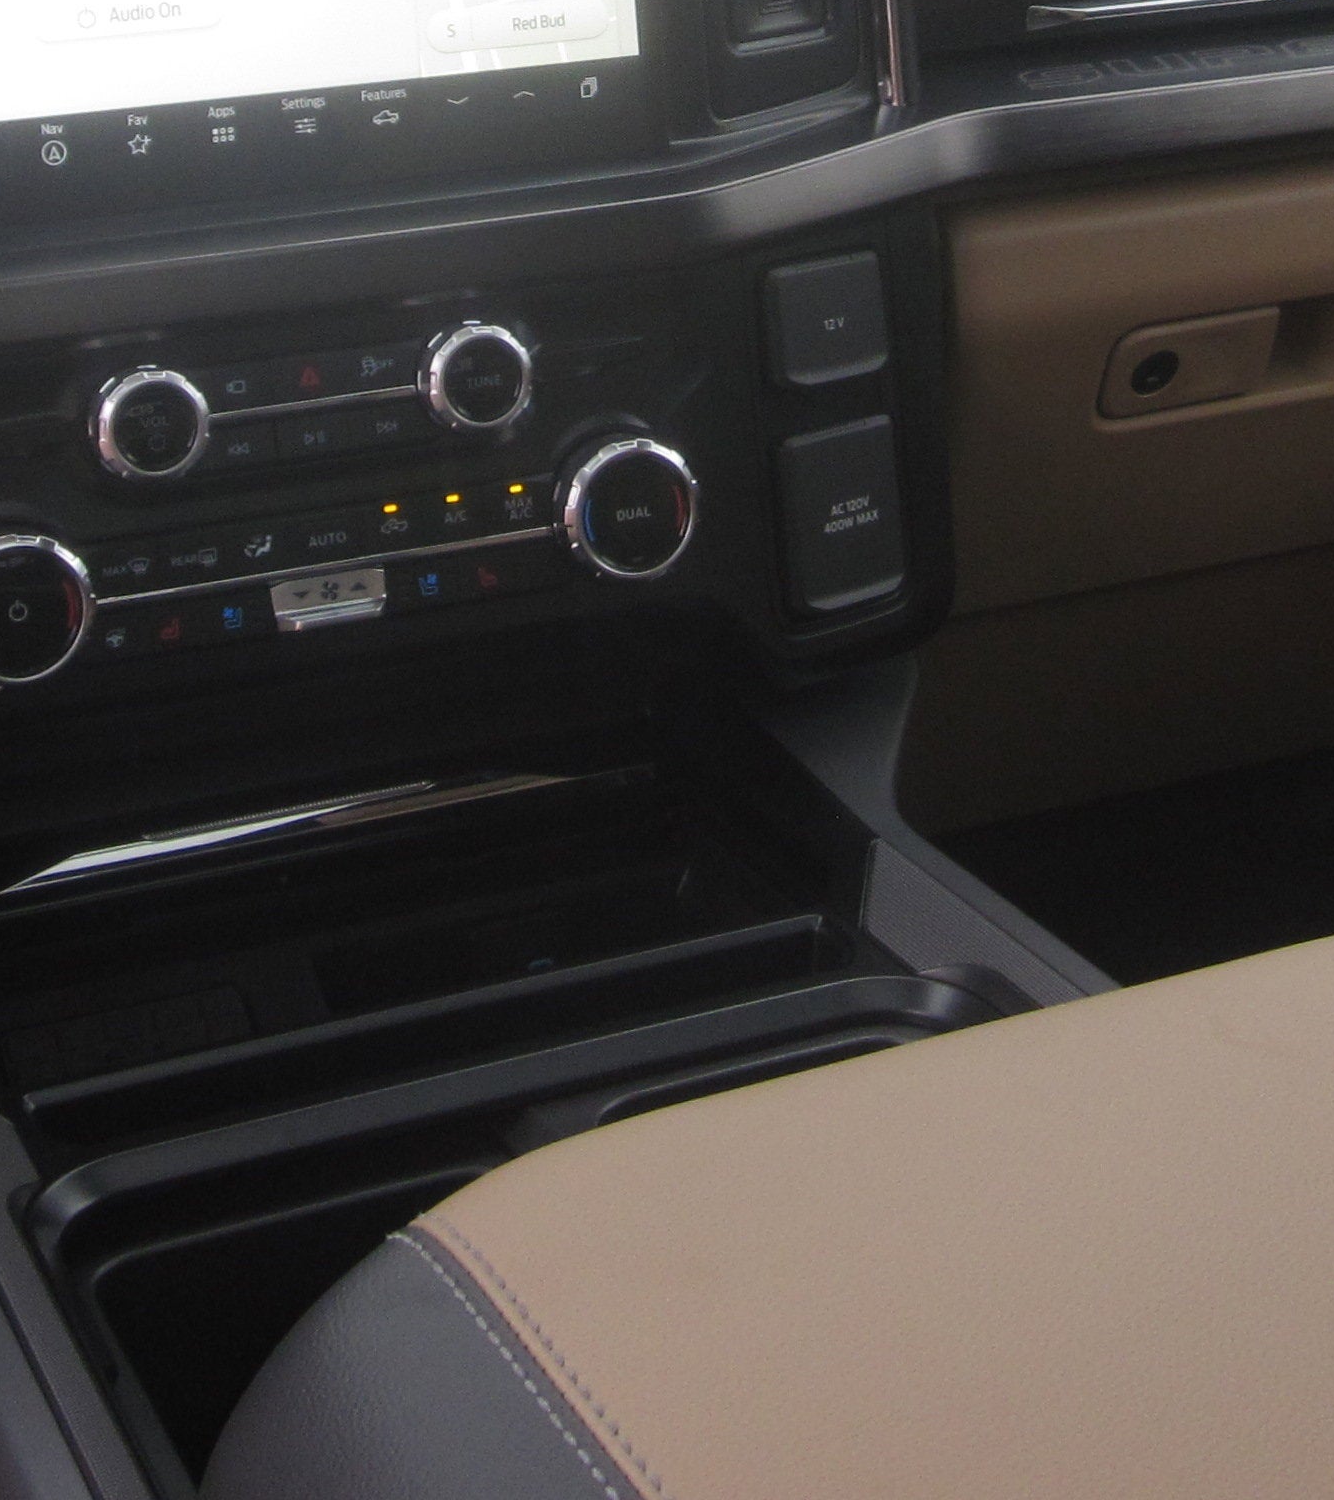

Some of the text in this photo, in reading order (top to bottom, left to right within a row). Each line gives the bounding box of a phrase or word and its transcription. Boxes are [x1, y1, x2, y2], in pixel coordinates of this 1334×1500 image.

[109, 1, 182, 23] Audio On
[512, 14, 566, 32] Red Bud
[446, 24, 456, 38] S
[361, 86, 407, 102] Features
[281, 95, 326, 112] Settings
[207, 106, 235, 120] Apps
[127, 114, 148, 127] Fav
[40, 123, 63, 136] Nav
[466, 374, 503, 388] TUNE
[504, 497, 533, 511] MAX
[831, 496, 870, 517] AC 120V
[444, 510, 467, 524] A/C
[509, 509, 533, 522] A/C
[616, 507, 652, 522] DUAL
[824, 509, 879, 534] 400W MAX
[308, 531, 347, 548] AUTO
